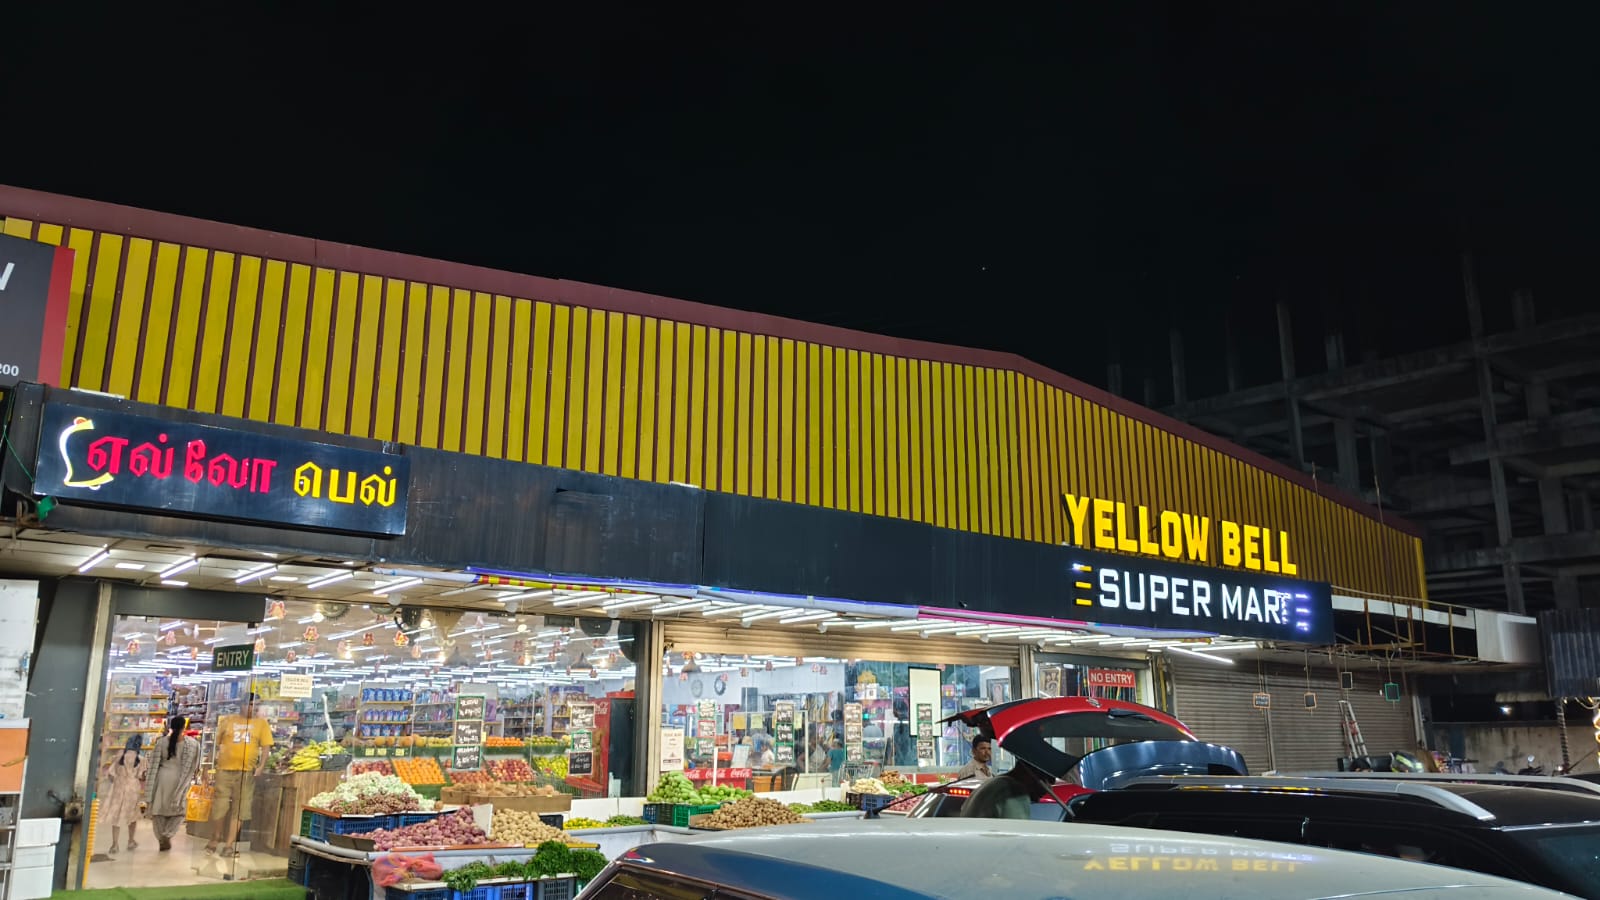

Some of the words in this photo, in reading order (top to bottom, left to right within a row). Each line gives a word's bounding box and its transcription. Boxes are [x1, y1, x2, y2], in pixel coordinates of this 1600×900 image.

[293, 461, 397, 508] பெல்
[1065, 493, 1209, 562] YELLOW
[1221, 520, 1297, 575] BELL
[1098, 568, 1210, 617] SUPER
[1221, 583, 1292, 625] MART
[216, 650, 250, 667] ENTRY
[1090, 672, 1105, 684] NO
[1105, 672, 1133, 686] ENTRY
